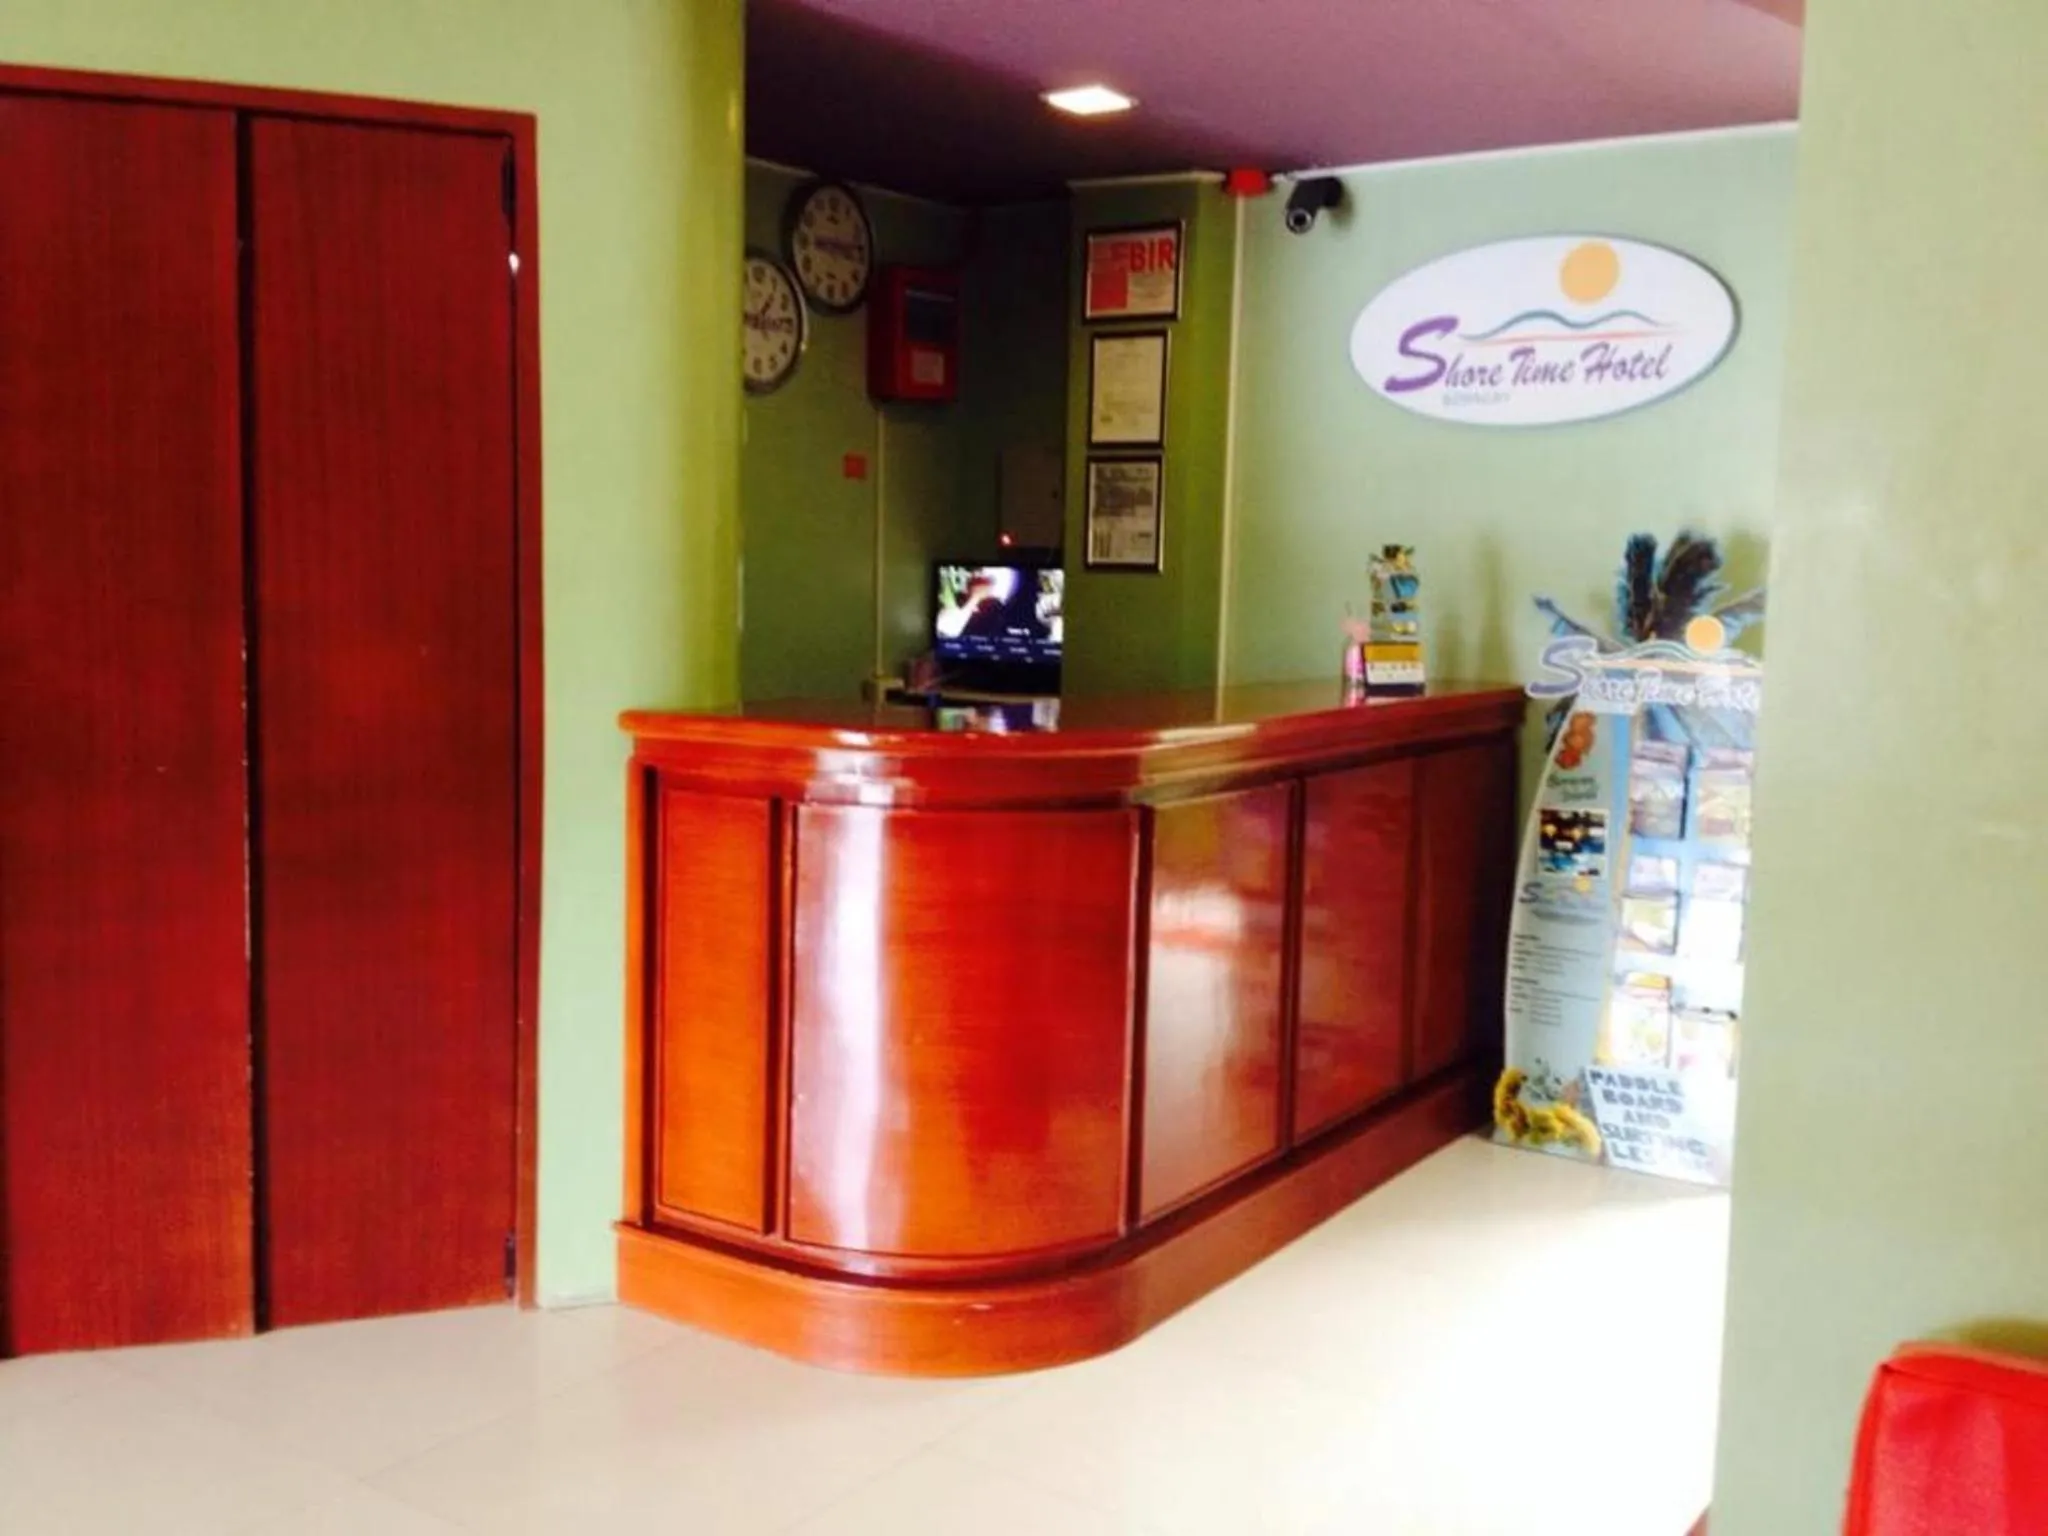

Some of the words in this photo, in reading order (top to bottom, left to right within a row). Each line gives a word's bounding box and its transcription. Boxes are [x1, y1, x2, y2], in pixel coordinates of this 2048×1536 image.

[1130, 237, 1174, 273] BIR
[1384, 315, 1503, 393] Shore
[1508, 345, 1576, 388] Time
[1580, 340, 1674, 384] Hotel
[1588, 1069, 1684, 1097] PADDLE
[1602, 1089, 1683, 1114] BOARD
[1623, 1109, 1671, 1129] AND
